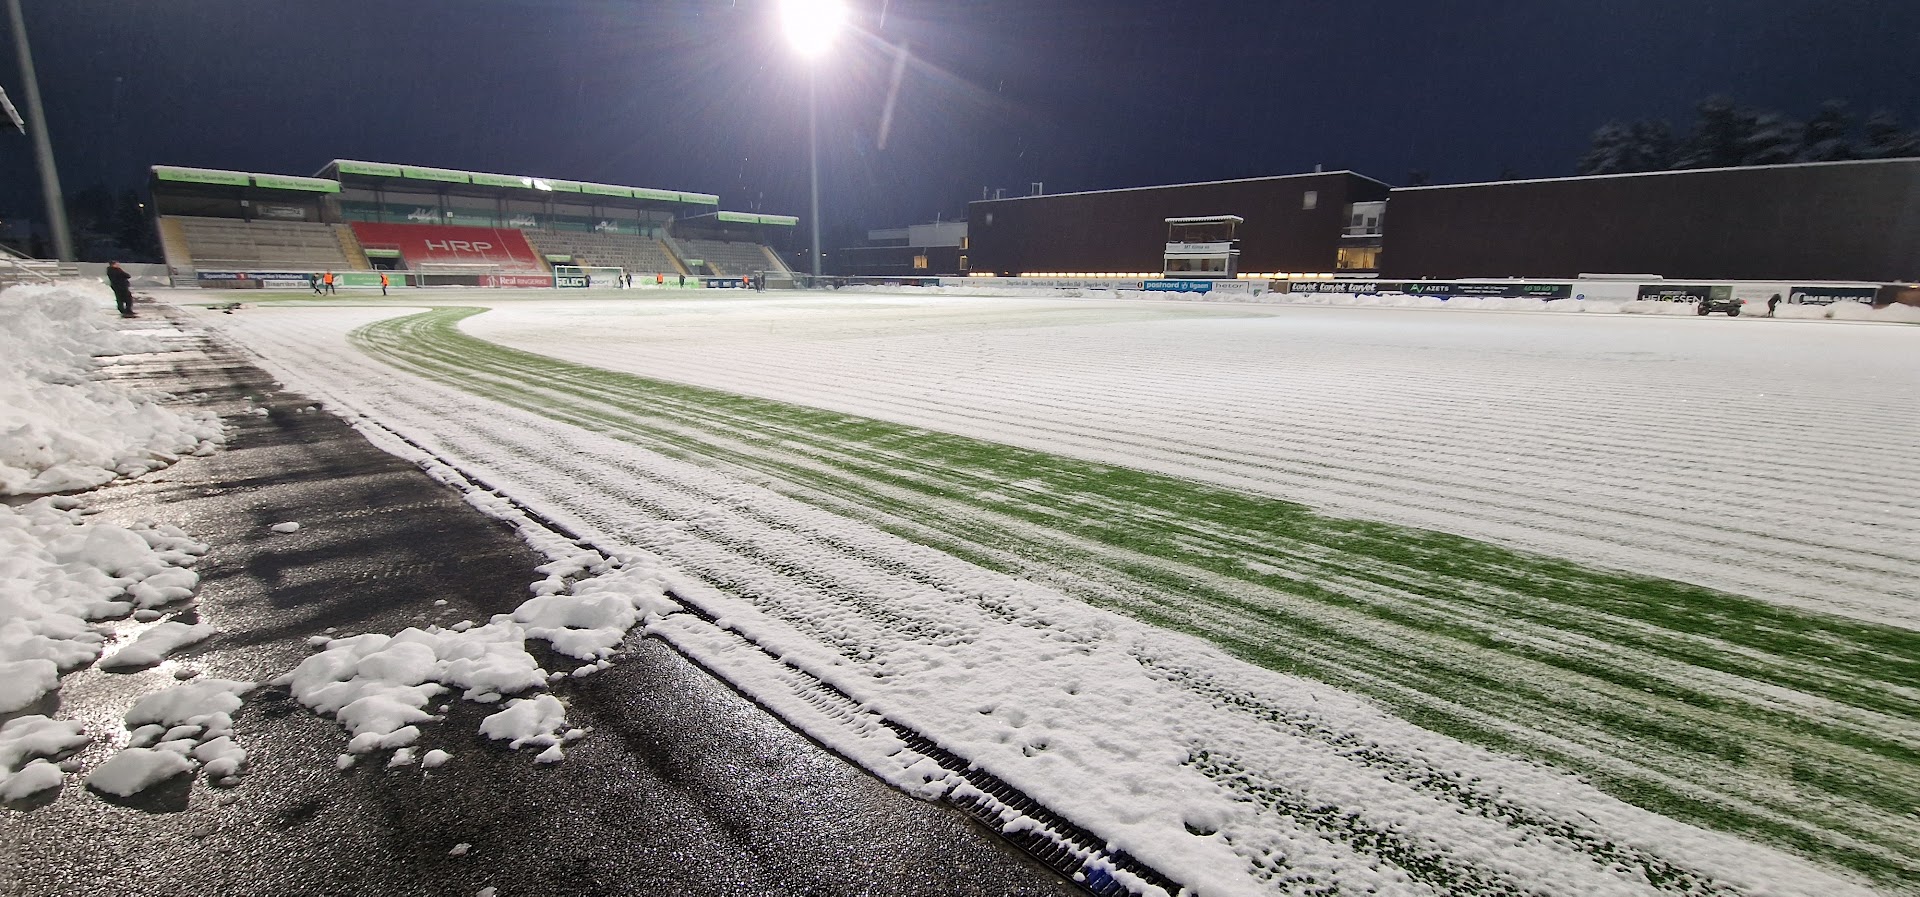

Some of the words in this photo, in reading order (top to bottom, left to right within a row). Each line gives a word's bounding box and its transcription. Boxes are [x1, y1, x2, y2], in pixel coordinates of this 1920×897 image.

[424, 239, 492, 252] HRP
[500, 277, 516, 285] Real
[558, 277, 587, 287] SELECT
[1146, 280, 1179, 289] postnord
[1189, 281, 1209, 290] ligaen
